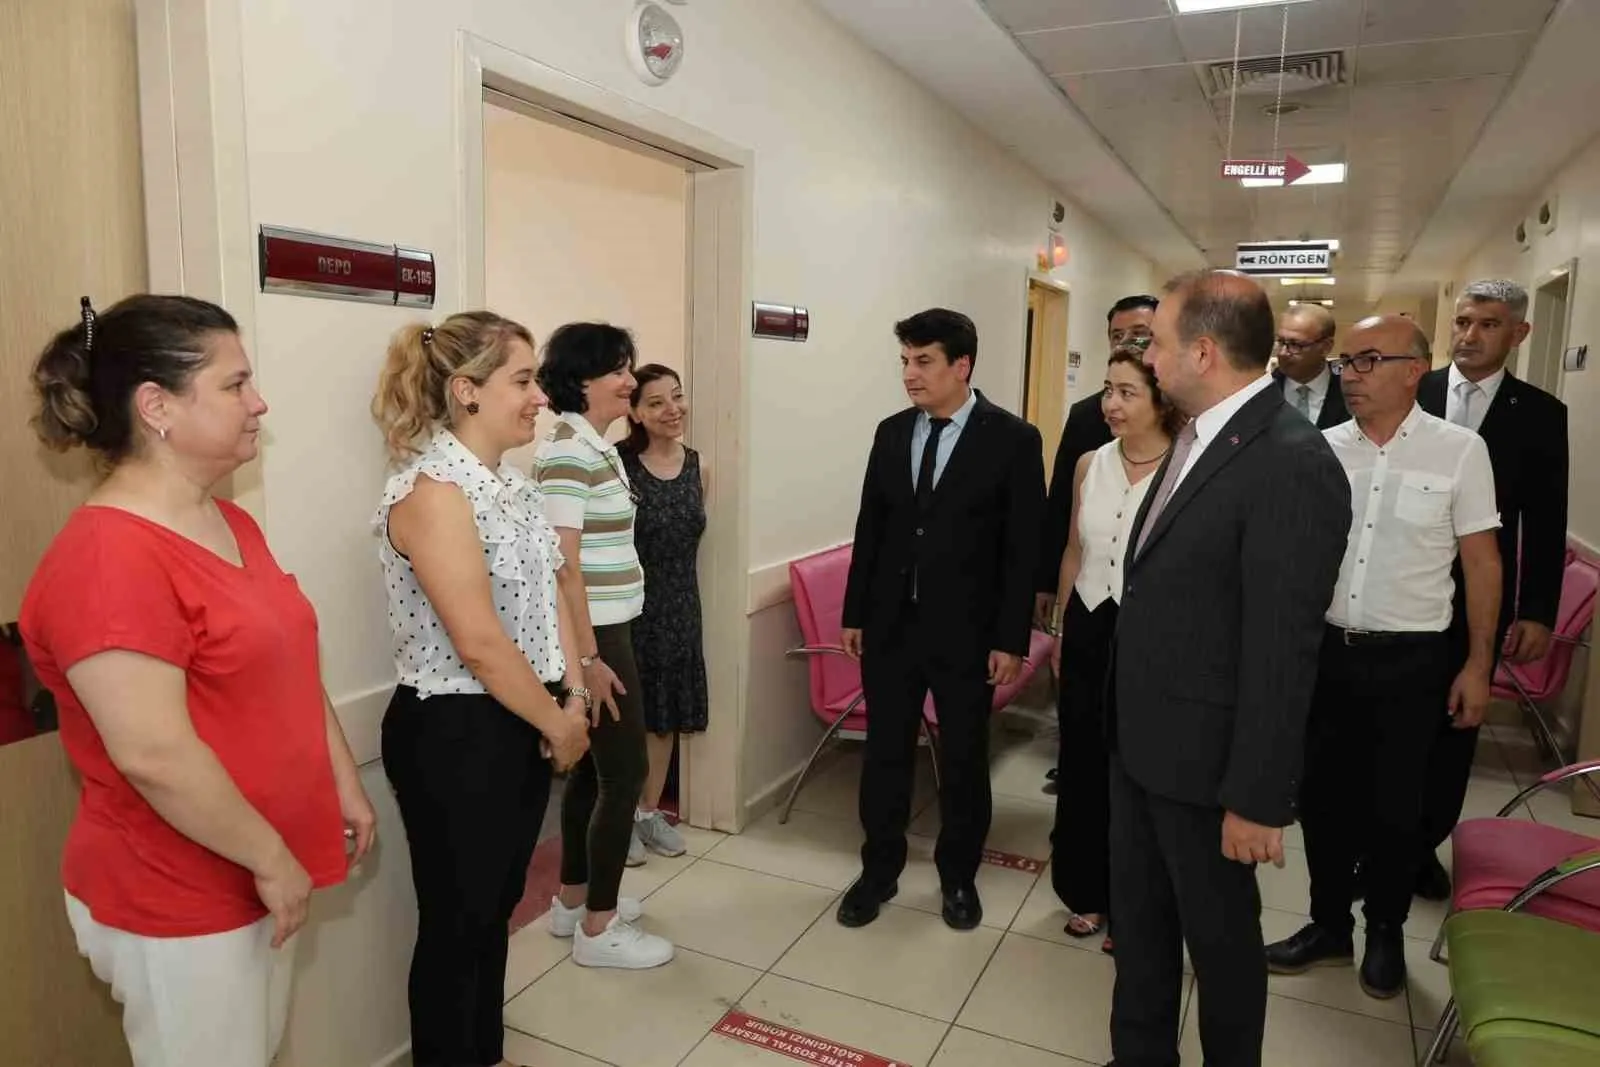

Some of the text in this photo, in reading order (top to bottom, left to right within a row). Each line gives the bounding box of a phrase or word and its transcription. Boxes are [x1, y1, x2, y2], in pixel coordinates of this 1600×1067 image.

[1223, 163, 1286, 177] ENGELLİ WC
[317, 256, 352, 276] DEPO
[1258, 253, 1326, 265] RÖNTGEN
[720, 1023, 769, 1044] MESAFE
[744, 1019, 788, 1038] KORUR
[770, 1038, 820, 1060] SOSYAL
